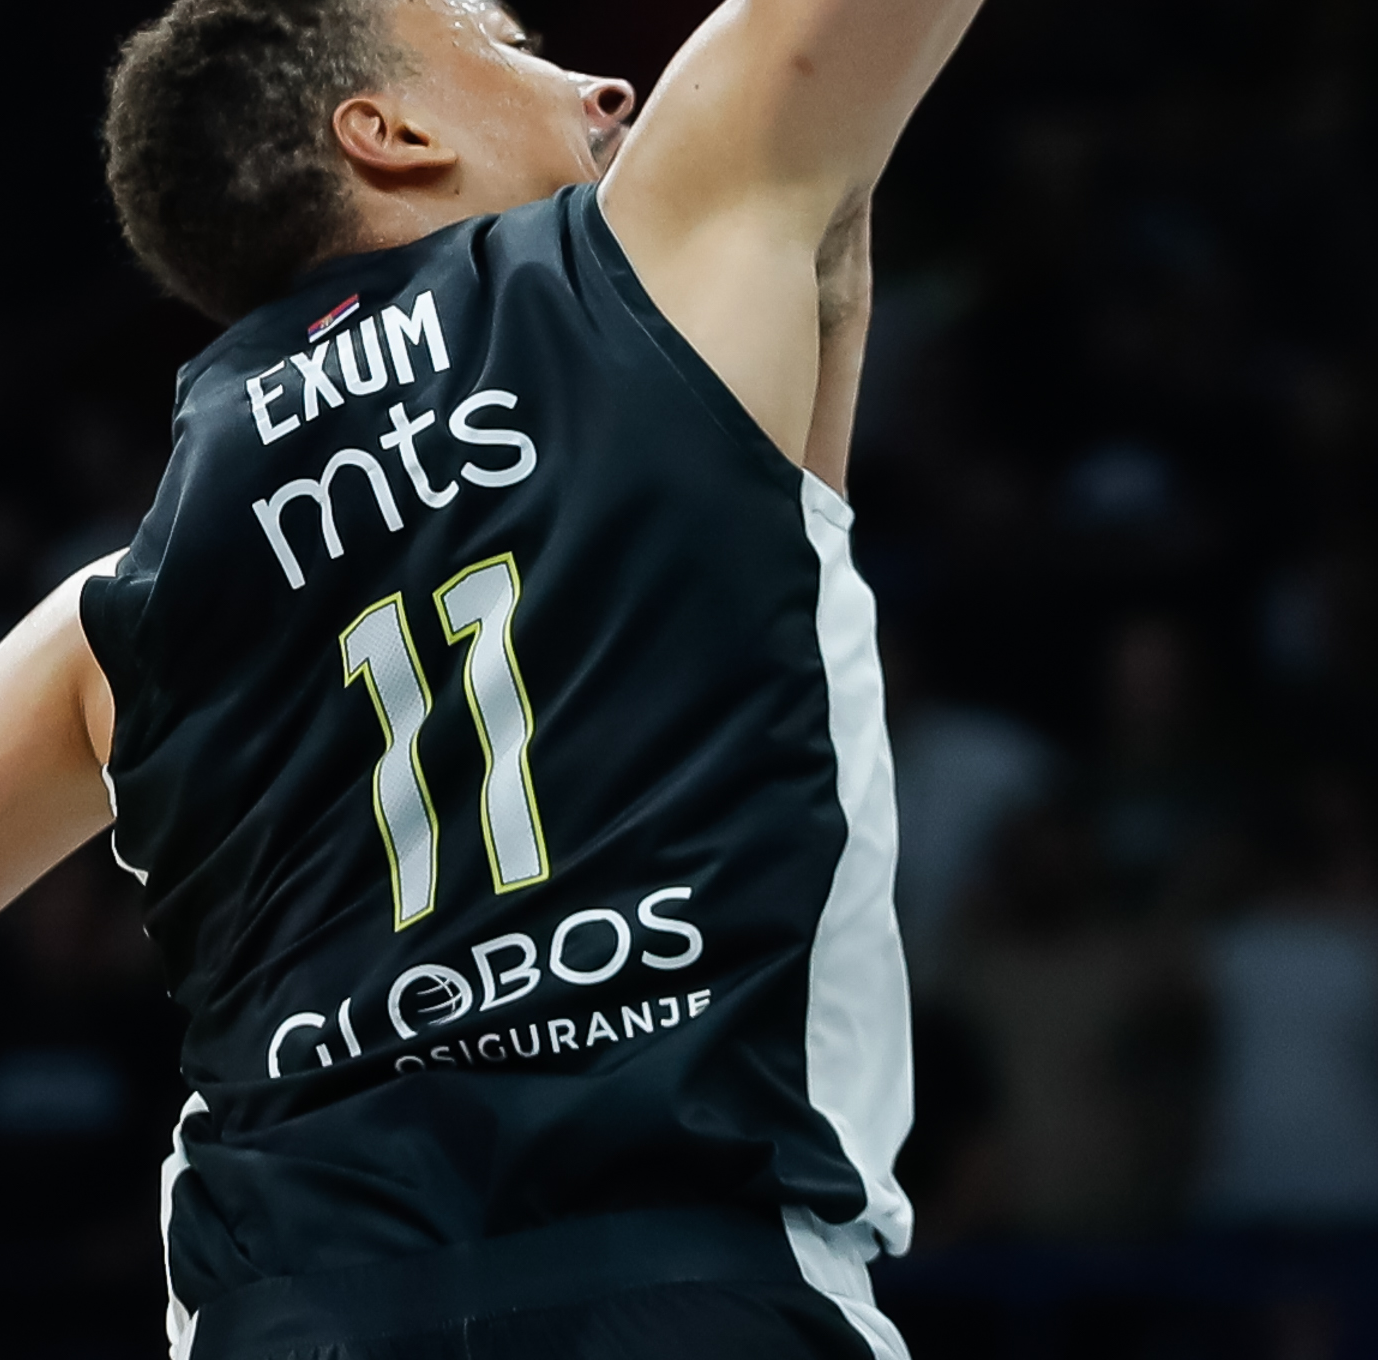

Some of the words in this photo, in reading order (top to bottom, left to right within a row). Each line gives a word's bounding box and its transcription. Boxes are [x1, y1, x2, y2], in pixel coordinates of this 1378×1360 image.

[246, 289, 451, 445] EXUM
[252, 388, 537, 589] mts
[338, 551, 550, 932] 11
